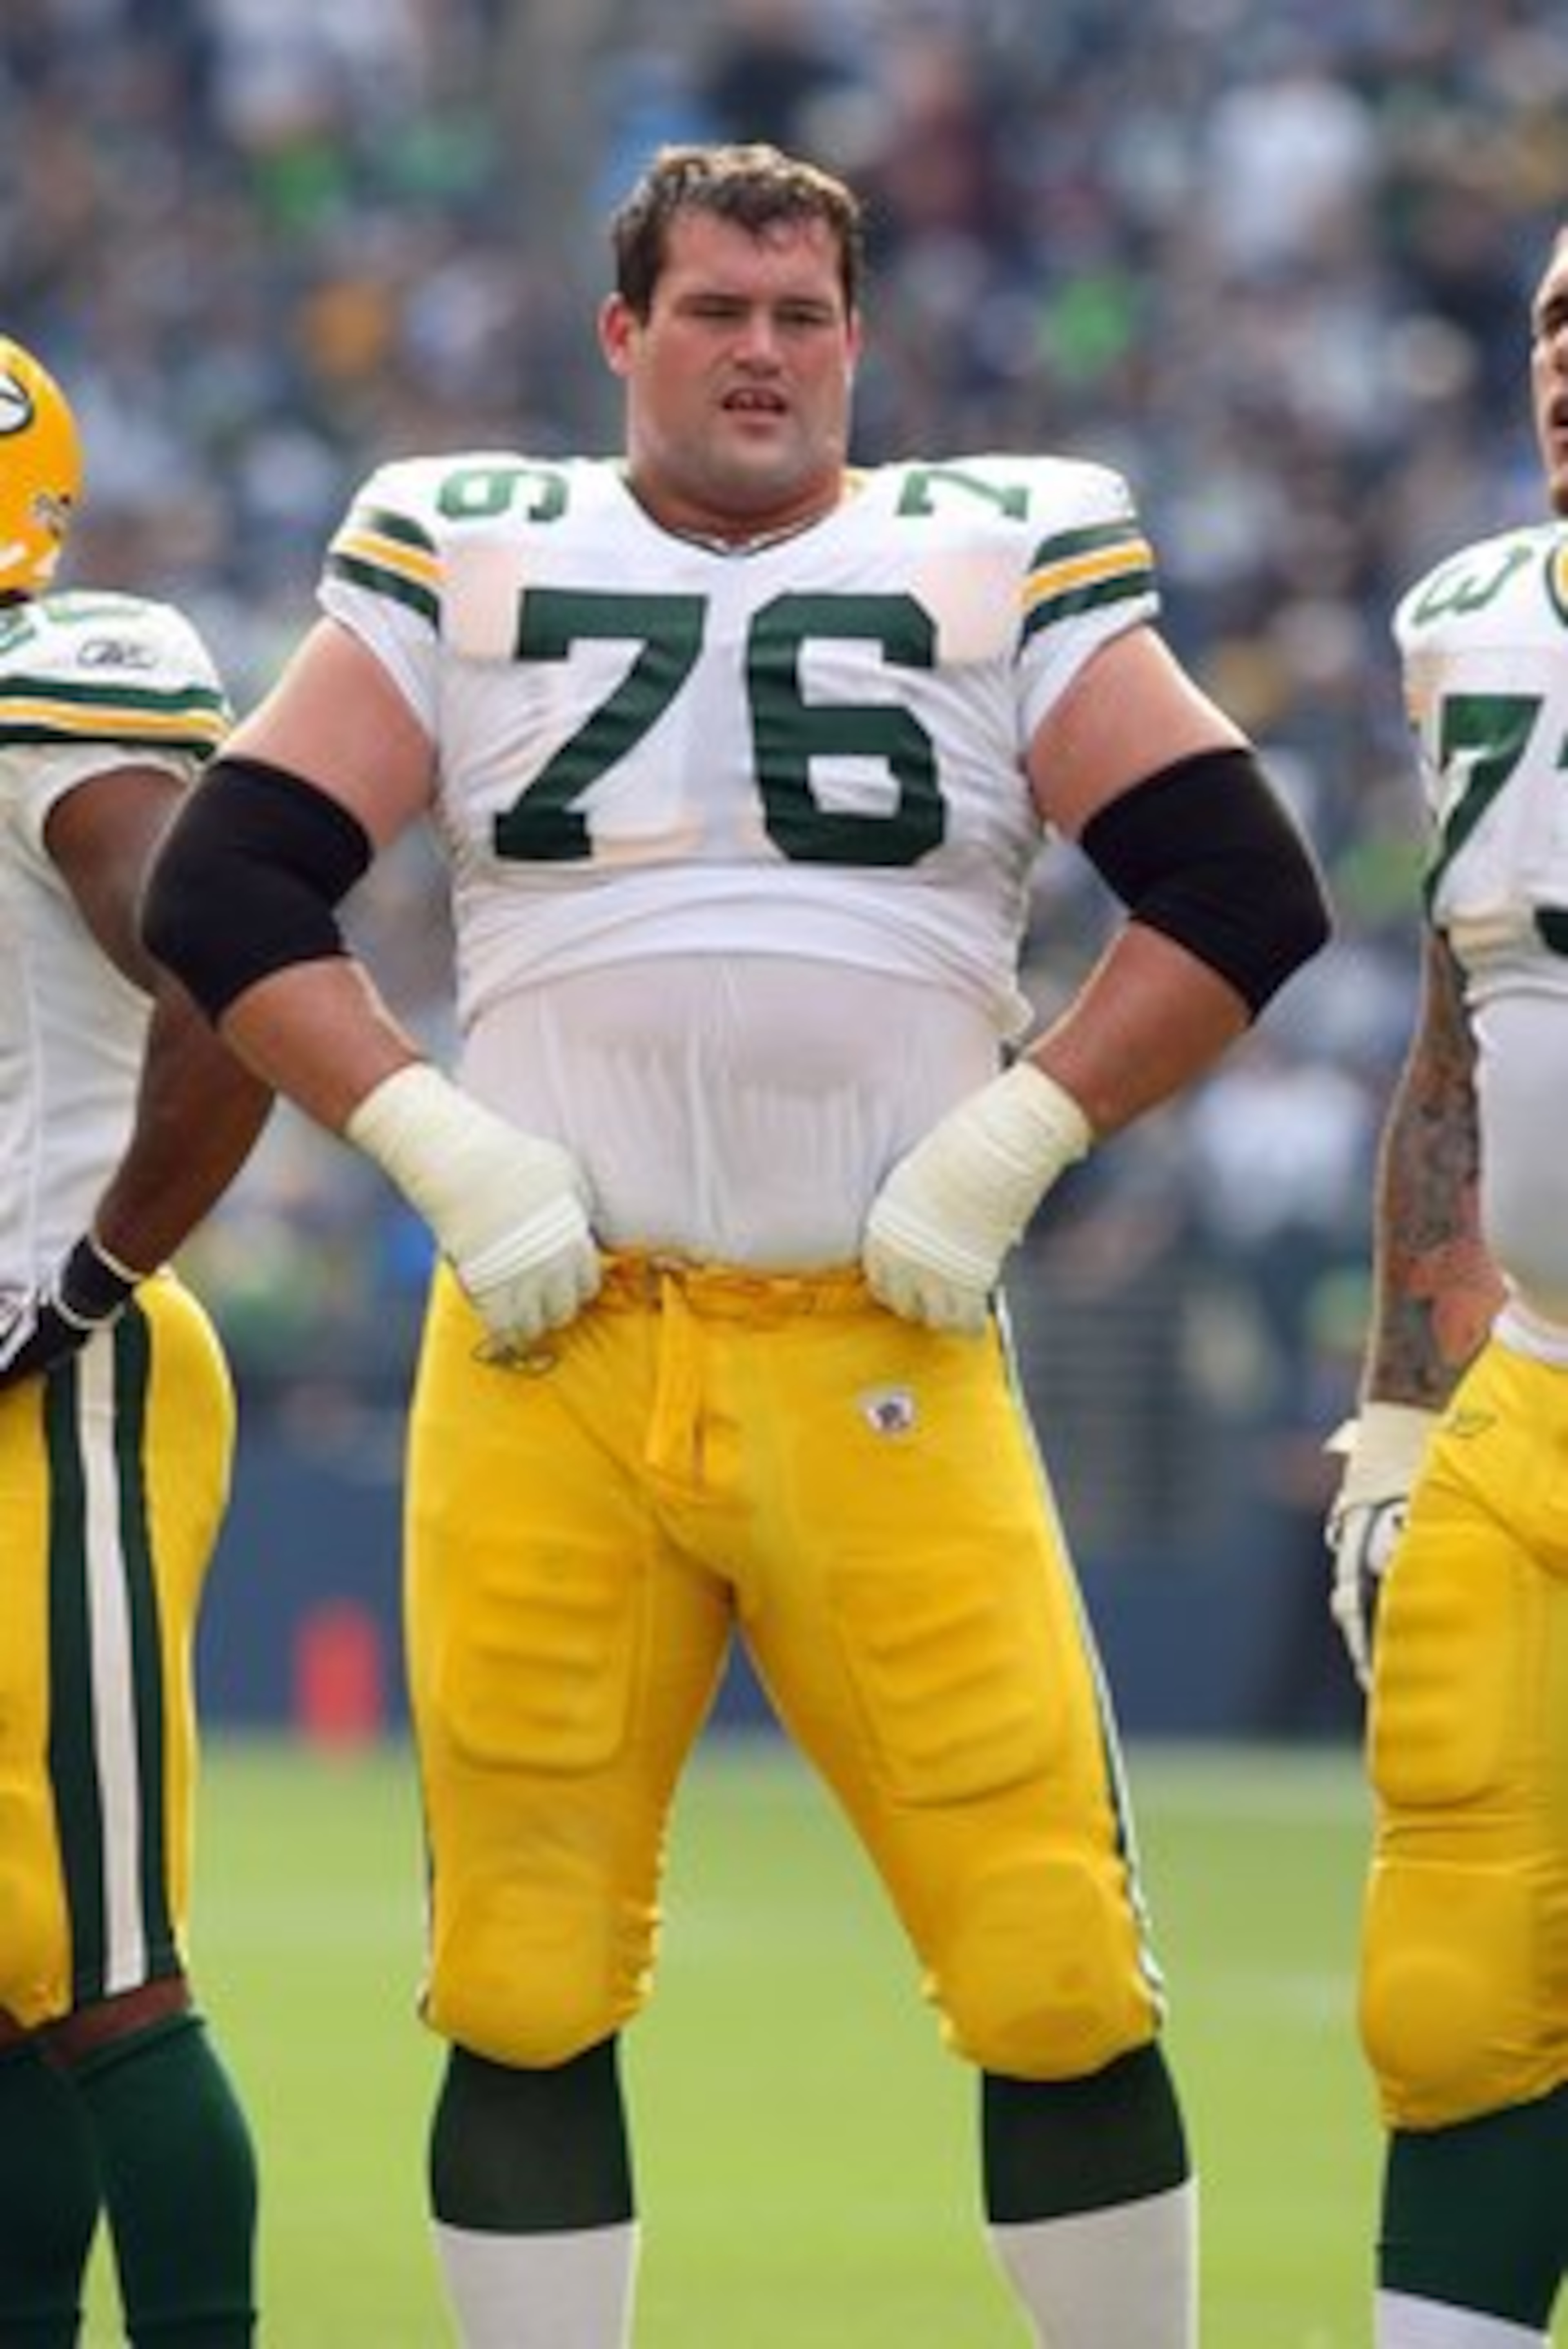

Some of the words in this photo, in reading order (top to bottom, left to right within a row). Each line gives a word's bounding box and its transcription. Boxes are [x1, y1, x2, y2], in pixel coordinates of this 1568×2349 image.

[897, 470, 1029, 522] 7
[491, 588, 948, 868] 76
[1421, 695, 1568, 958] 7
